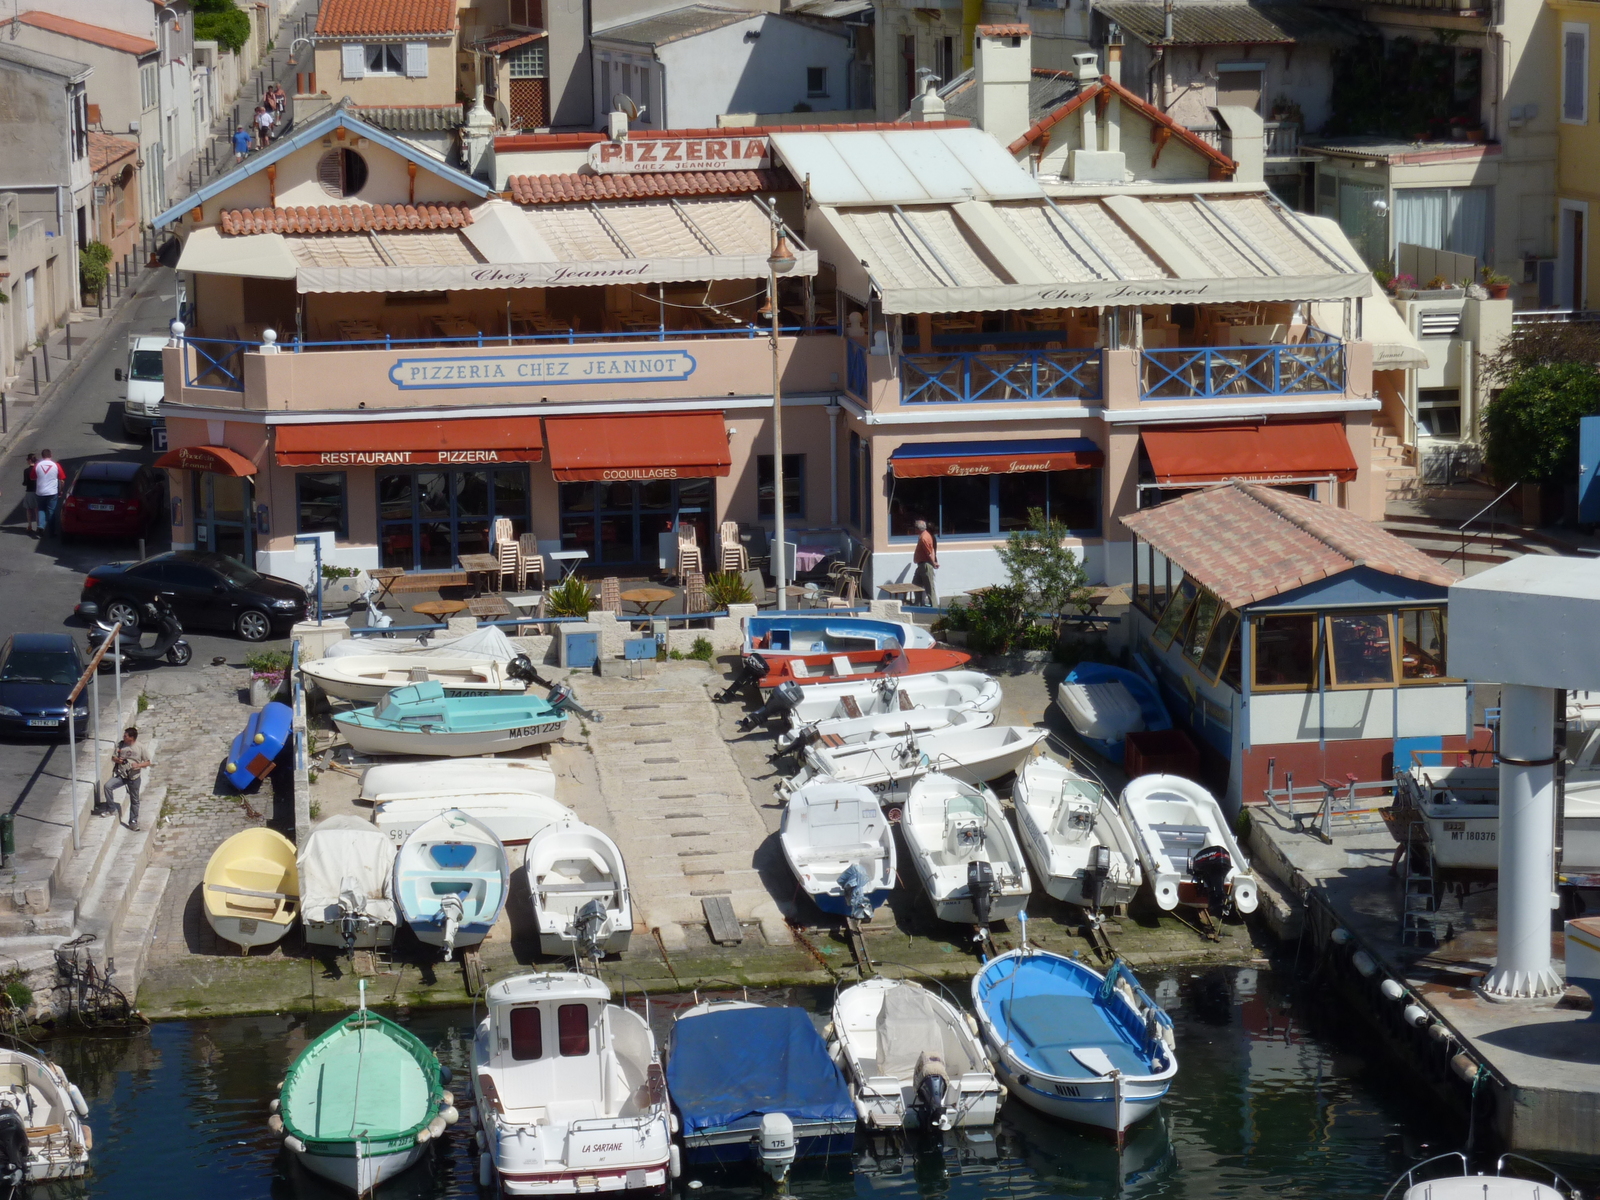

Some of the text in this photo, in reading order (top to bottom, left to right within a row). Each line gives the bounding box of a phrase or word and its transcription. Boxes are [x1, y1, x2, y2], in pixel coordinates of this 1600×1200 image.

[600, 140, 769, 163] PIZZERIA
[675, 161, 727, 169] JEANNOT
[471, 264, 650, 284] Chez Jeannot
[1038, 285, 1209, 302] Chez Jeannot
[410, 358, 677, 380] PIZZERIA CHEZ JEANNOT
[321, 450, 498, 464] RESTAURANT PIZZERIA
[603, 468, 677, 479] COQUILLAGES
[947, 460, 1051, 476] Pizzeria Jeannot
[1221, 475, 1293, 485] CQUILLAGES
[509, 723, 561, 739] MA 631 229
[1451, 831, 1496, 841] MT 180376
[1055, 1084, 1080, 1097] NINI
[581, 1142, 623, 1153] LA SARTANE
